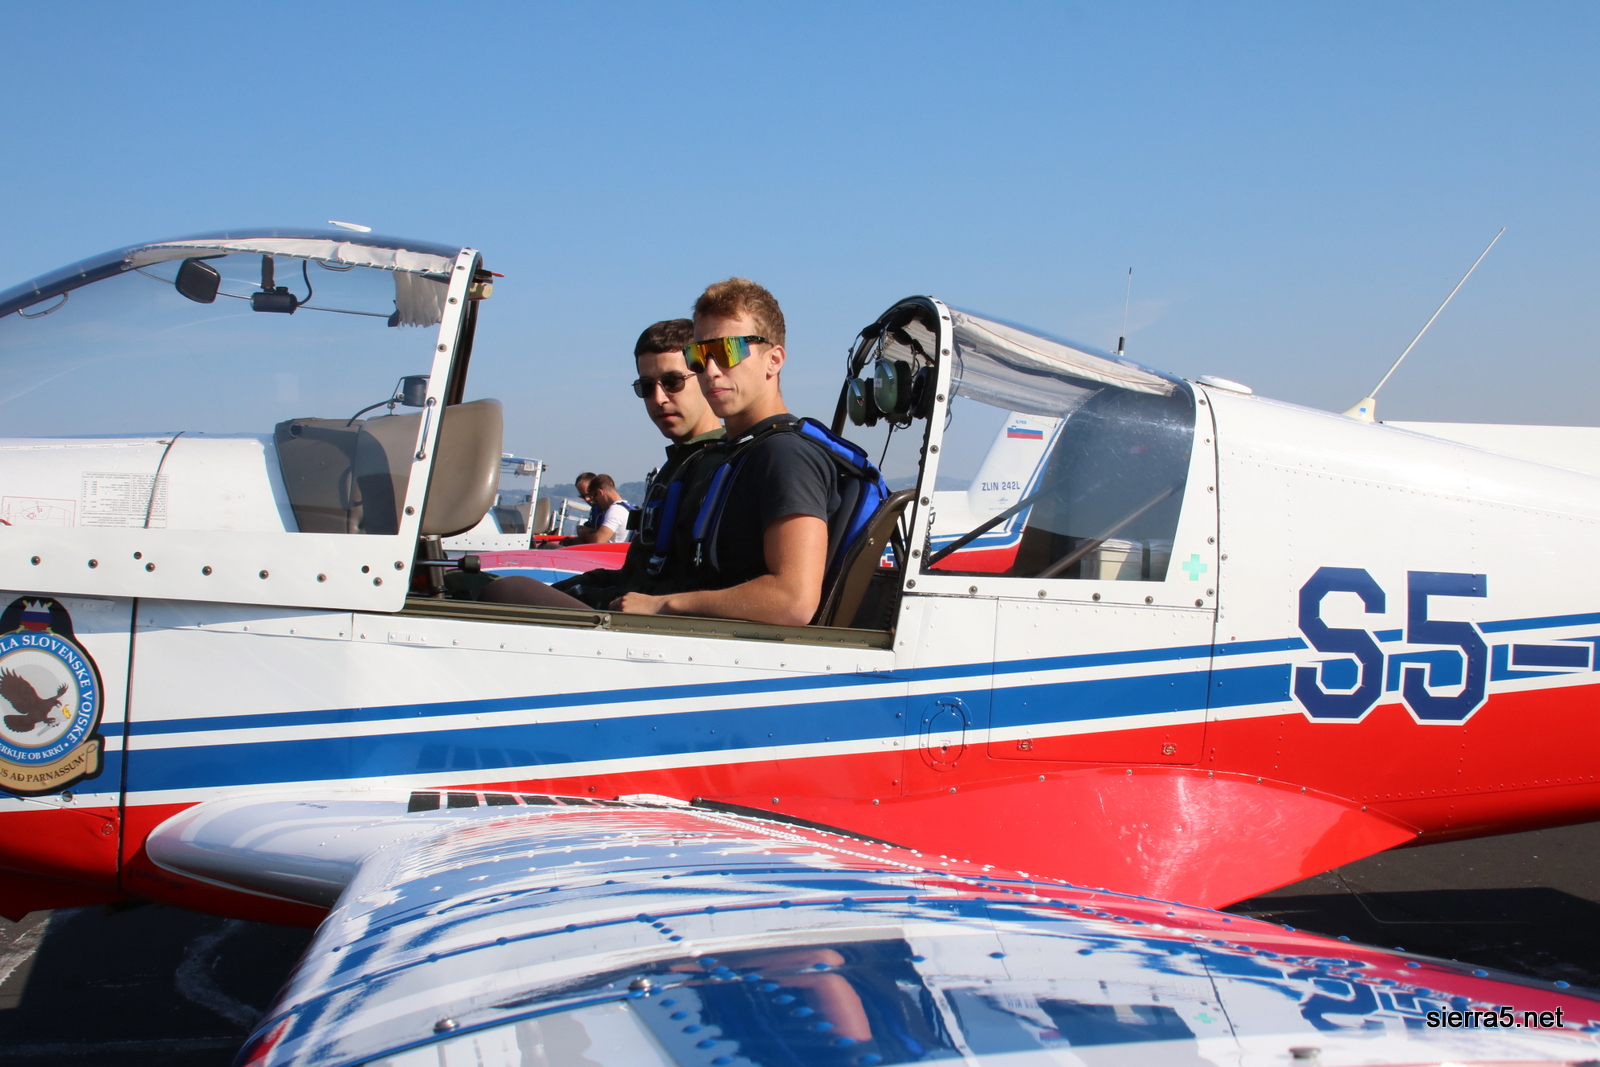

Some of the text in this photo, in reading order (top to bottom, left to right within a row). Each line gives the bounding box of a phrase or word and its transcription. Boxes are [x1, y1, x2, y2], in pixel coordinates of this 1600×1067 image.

[981, 481, 1021, 491] ZLIN 242L
[0, 634, 93, 744] LA SLOVENSKE VOJSKE
[27, 752, 41, 760] OB
[42, 744, 64, 759] KRKI
